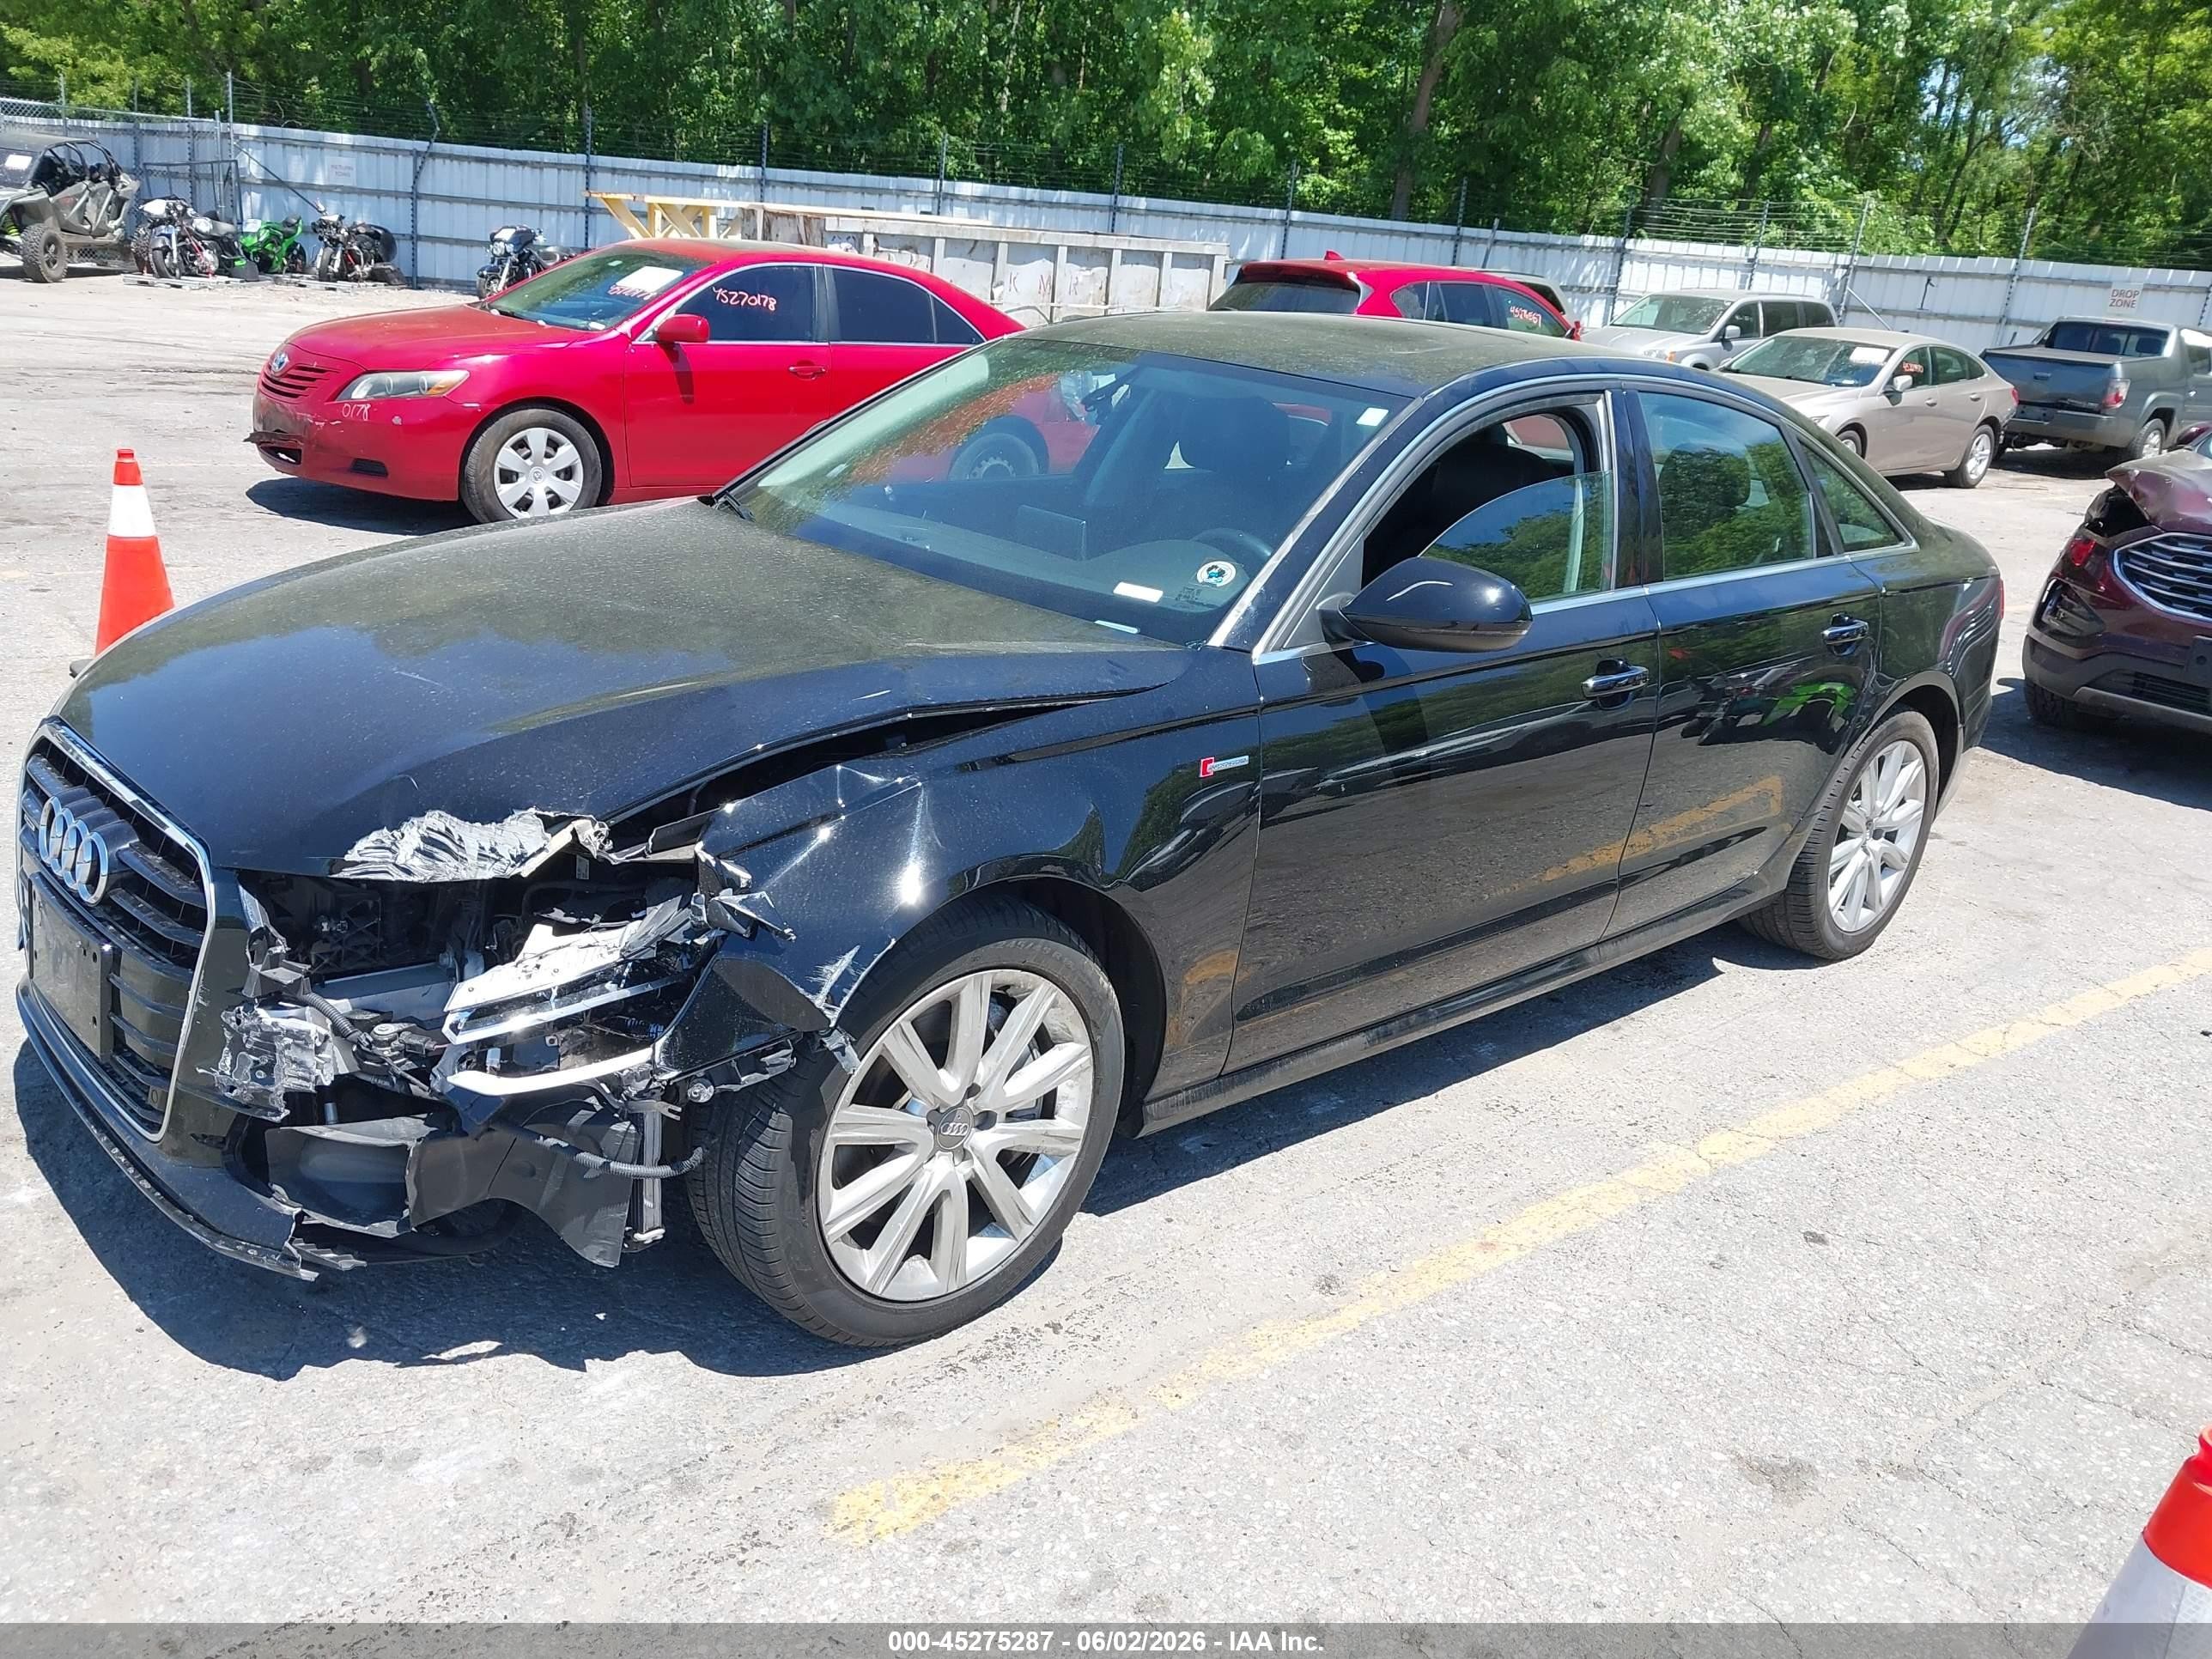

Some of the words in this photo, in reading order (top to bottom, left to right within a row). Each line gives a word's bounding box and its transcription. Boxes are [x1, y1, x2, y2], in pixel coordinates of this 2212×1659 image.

[712, 286, 777, 311] 45270178
[2111, 289, 2140, 299] DROP
[2108, 298, 2137, 308] ZONE
[342, 403, 372, 422] 0178
